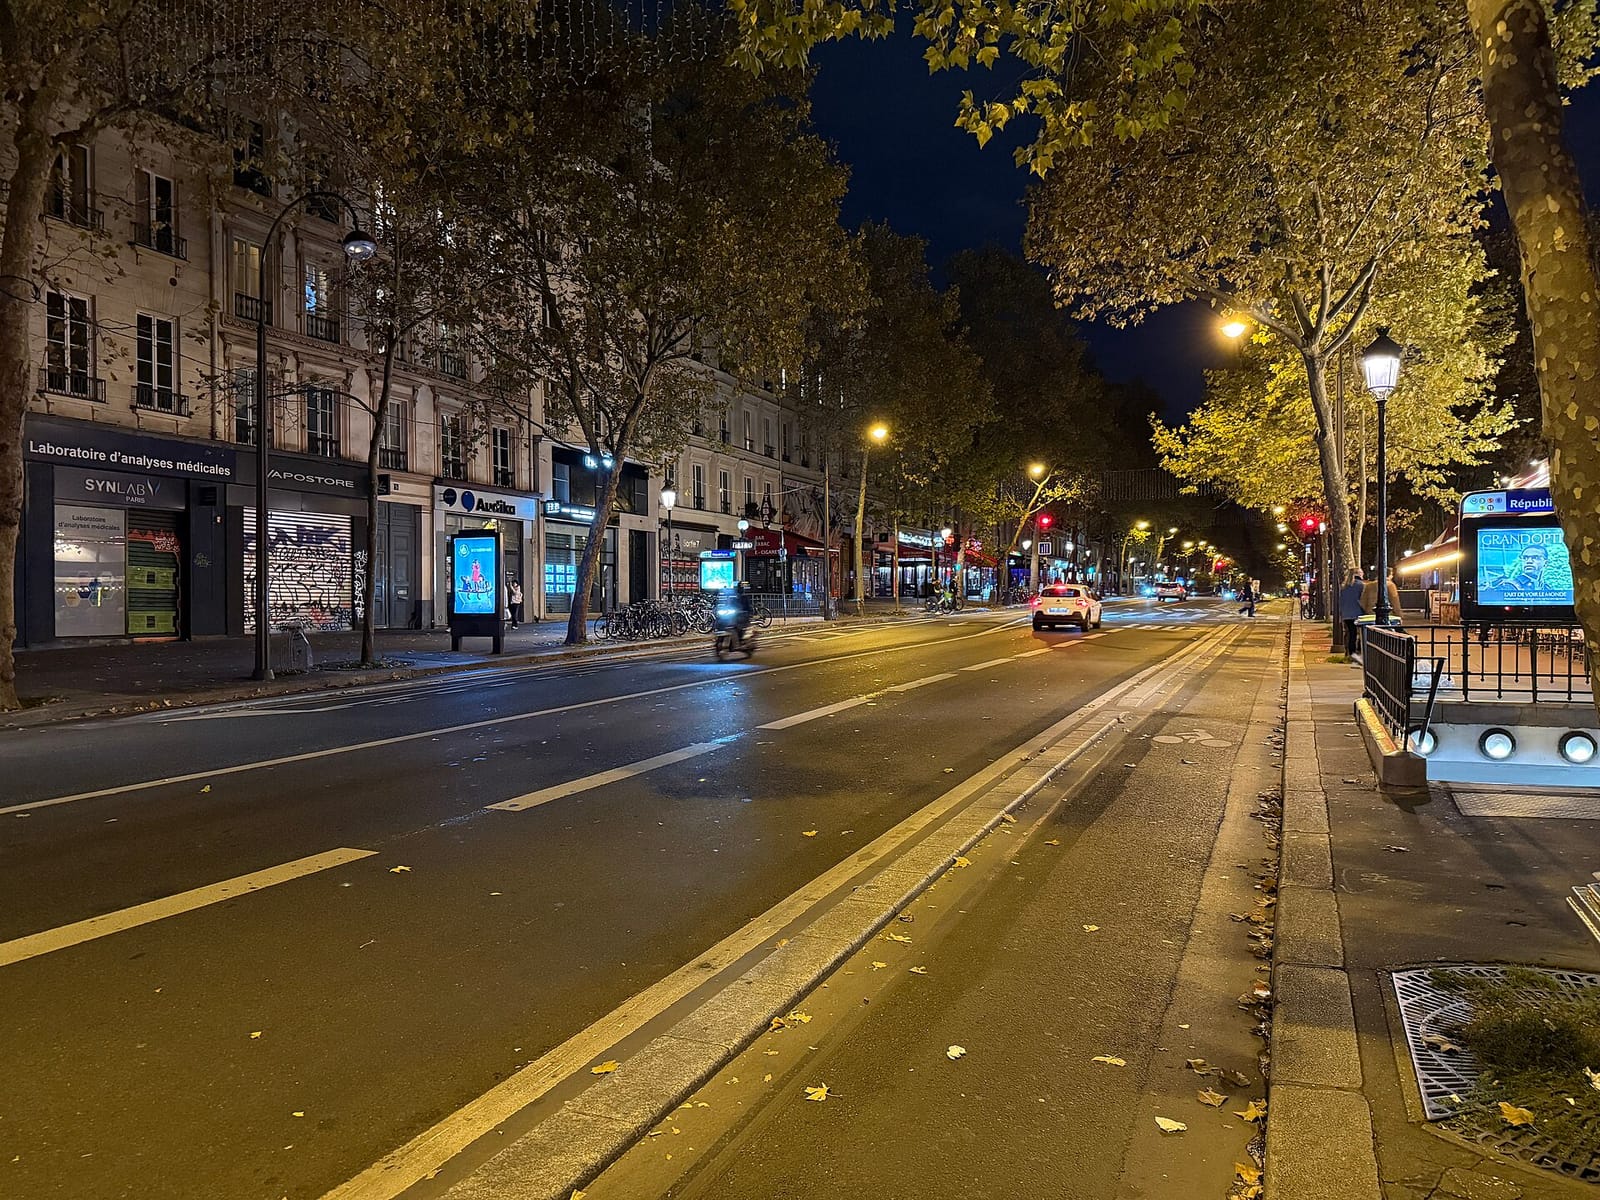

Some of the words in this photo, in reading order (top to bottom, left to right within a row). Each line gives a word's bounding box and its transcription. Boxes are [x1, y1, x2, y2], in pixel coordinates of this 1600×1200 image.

[29, 440, 106, 461] Laboratoire
[109, 451, 174, 469] d'analyses
[176, 460, 231, 476] médicales
[85, 478, 145, 496] SYNLAB
[476, 498, 516, 516] Audika
[762, 495, 770, 527] TABAC
[71, 514, 106, 523] Laboratoire
